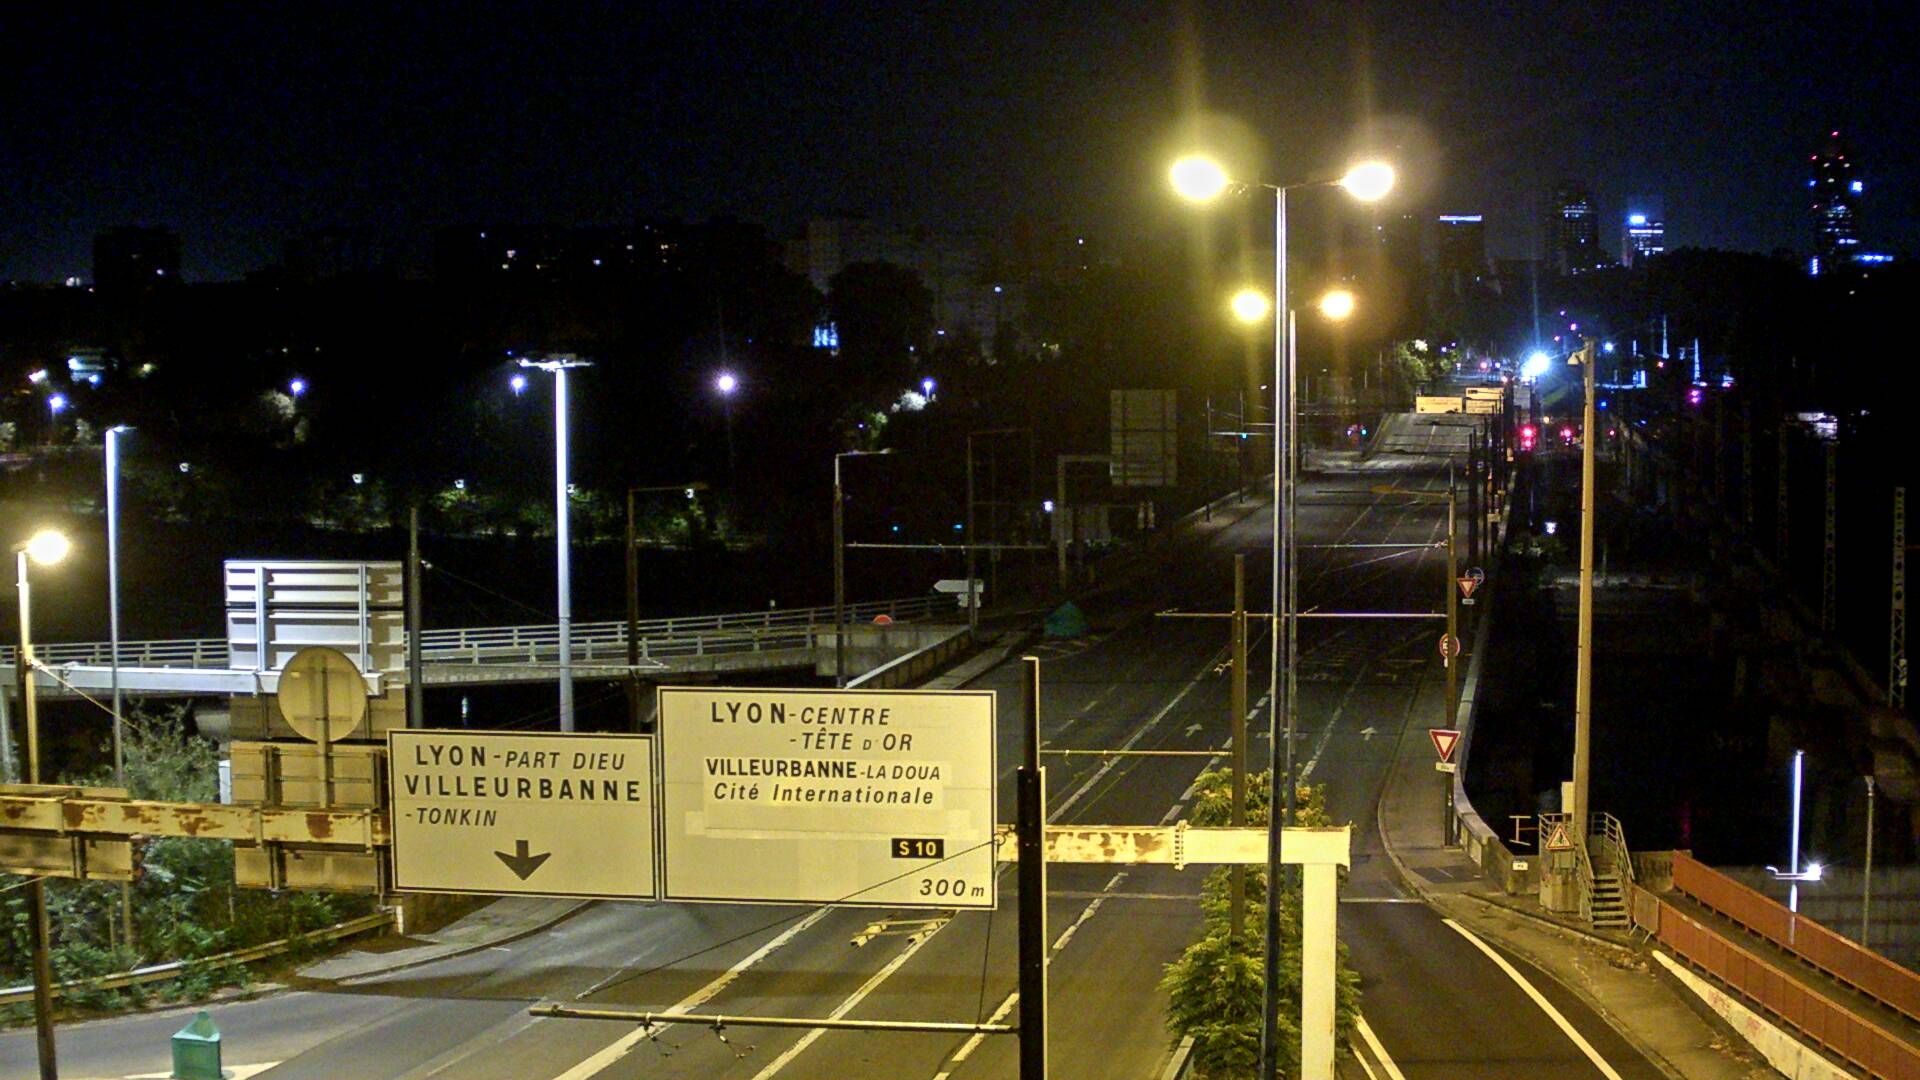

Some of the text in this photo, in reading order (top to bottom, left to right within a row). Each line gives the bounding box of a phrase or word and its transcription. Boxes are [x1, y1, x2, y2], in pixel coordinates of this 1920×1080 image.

[572, 752, 626, 771] DIEU
[891, 765, 941, 780] DOUA
[404, 774, 641, 802] VILLEURBANNE
[713, 782, 934, 805] Cité Internationale
[919, 878, 985, 897] 300 m
